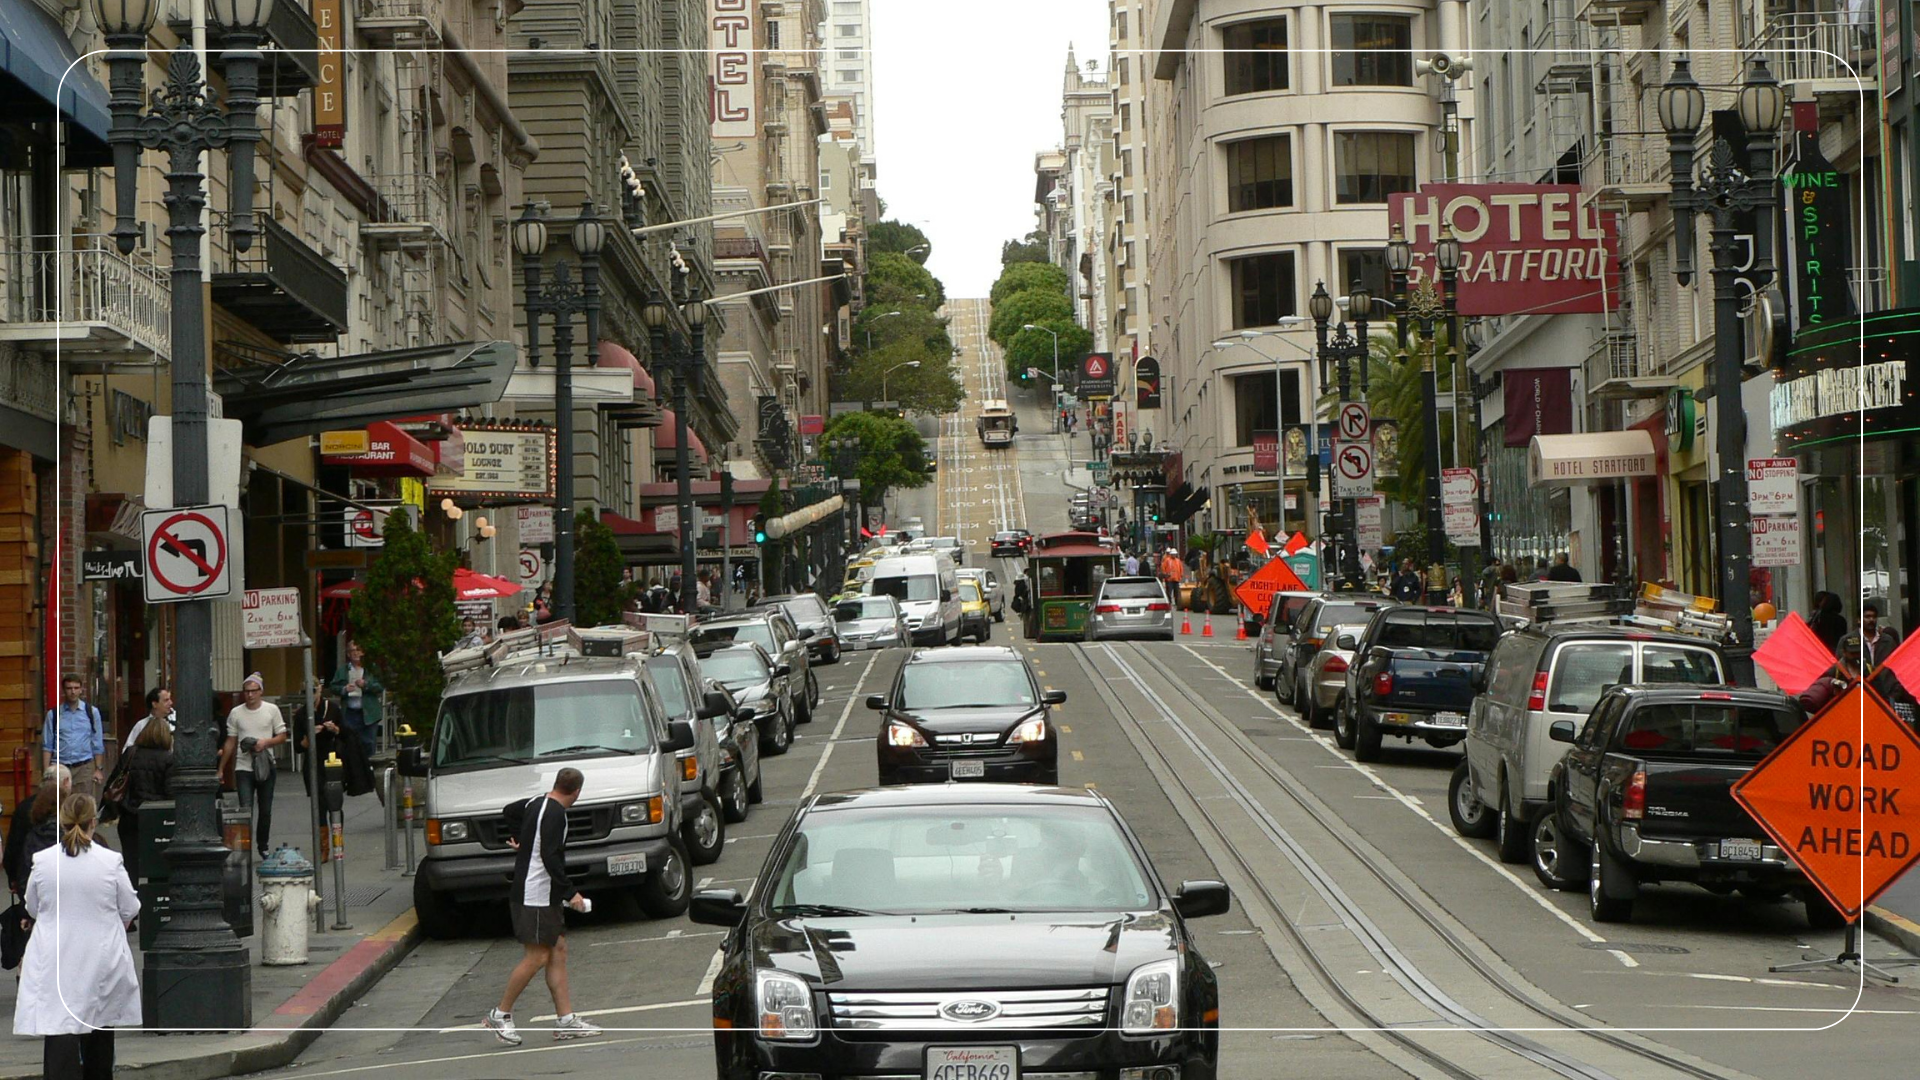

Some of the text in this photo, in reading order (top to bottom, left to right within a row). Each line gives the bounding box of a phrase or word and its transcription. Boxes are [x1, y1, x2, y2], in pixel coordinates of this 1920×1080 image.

[317, 130, 341, 139] HOTEL
[1780, 171, 1838, 188] WINE
[1403, 192, 1606, 246] HOTEL
[1406, 247, 1608, 285] STRATFORD
[1803, 206, 1823, 324] SPIRITS
[1116, 412, 1124, 444] PARK
[371, 442, 390, 450] BAR
[490, 443, 515, 455] DUST
[472, 458, 502, 468] LOUNGE
[1554, 461, 1584, 475] HOTEL
[1749, 468, 1795, 480] NO STOPPING
[1753, 520, 1798, 532] NO PARKING
[1250, 581, 1298, 591] RIGHT LANE
[243, 592, 296, 608] NO PARKING
[1811, 739, 1901, 772] ROAD
[1808, 782, 1900, 816] WORK
[1796, 826, 1910, 860] AHEAD
[955, 1002, 987, 1014] Ford
[946, 1050, 999, 1064] California
